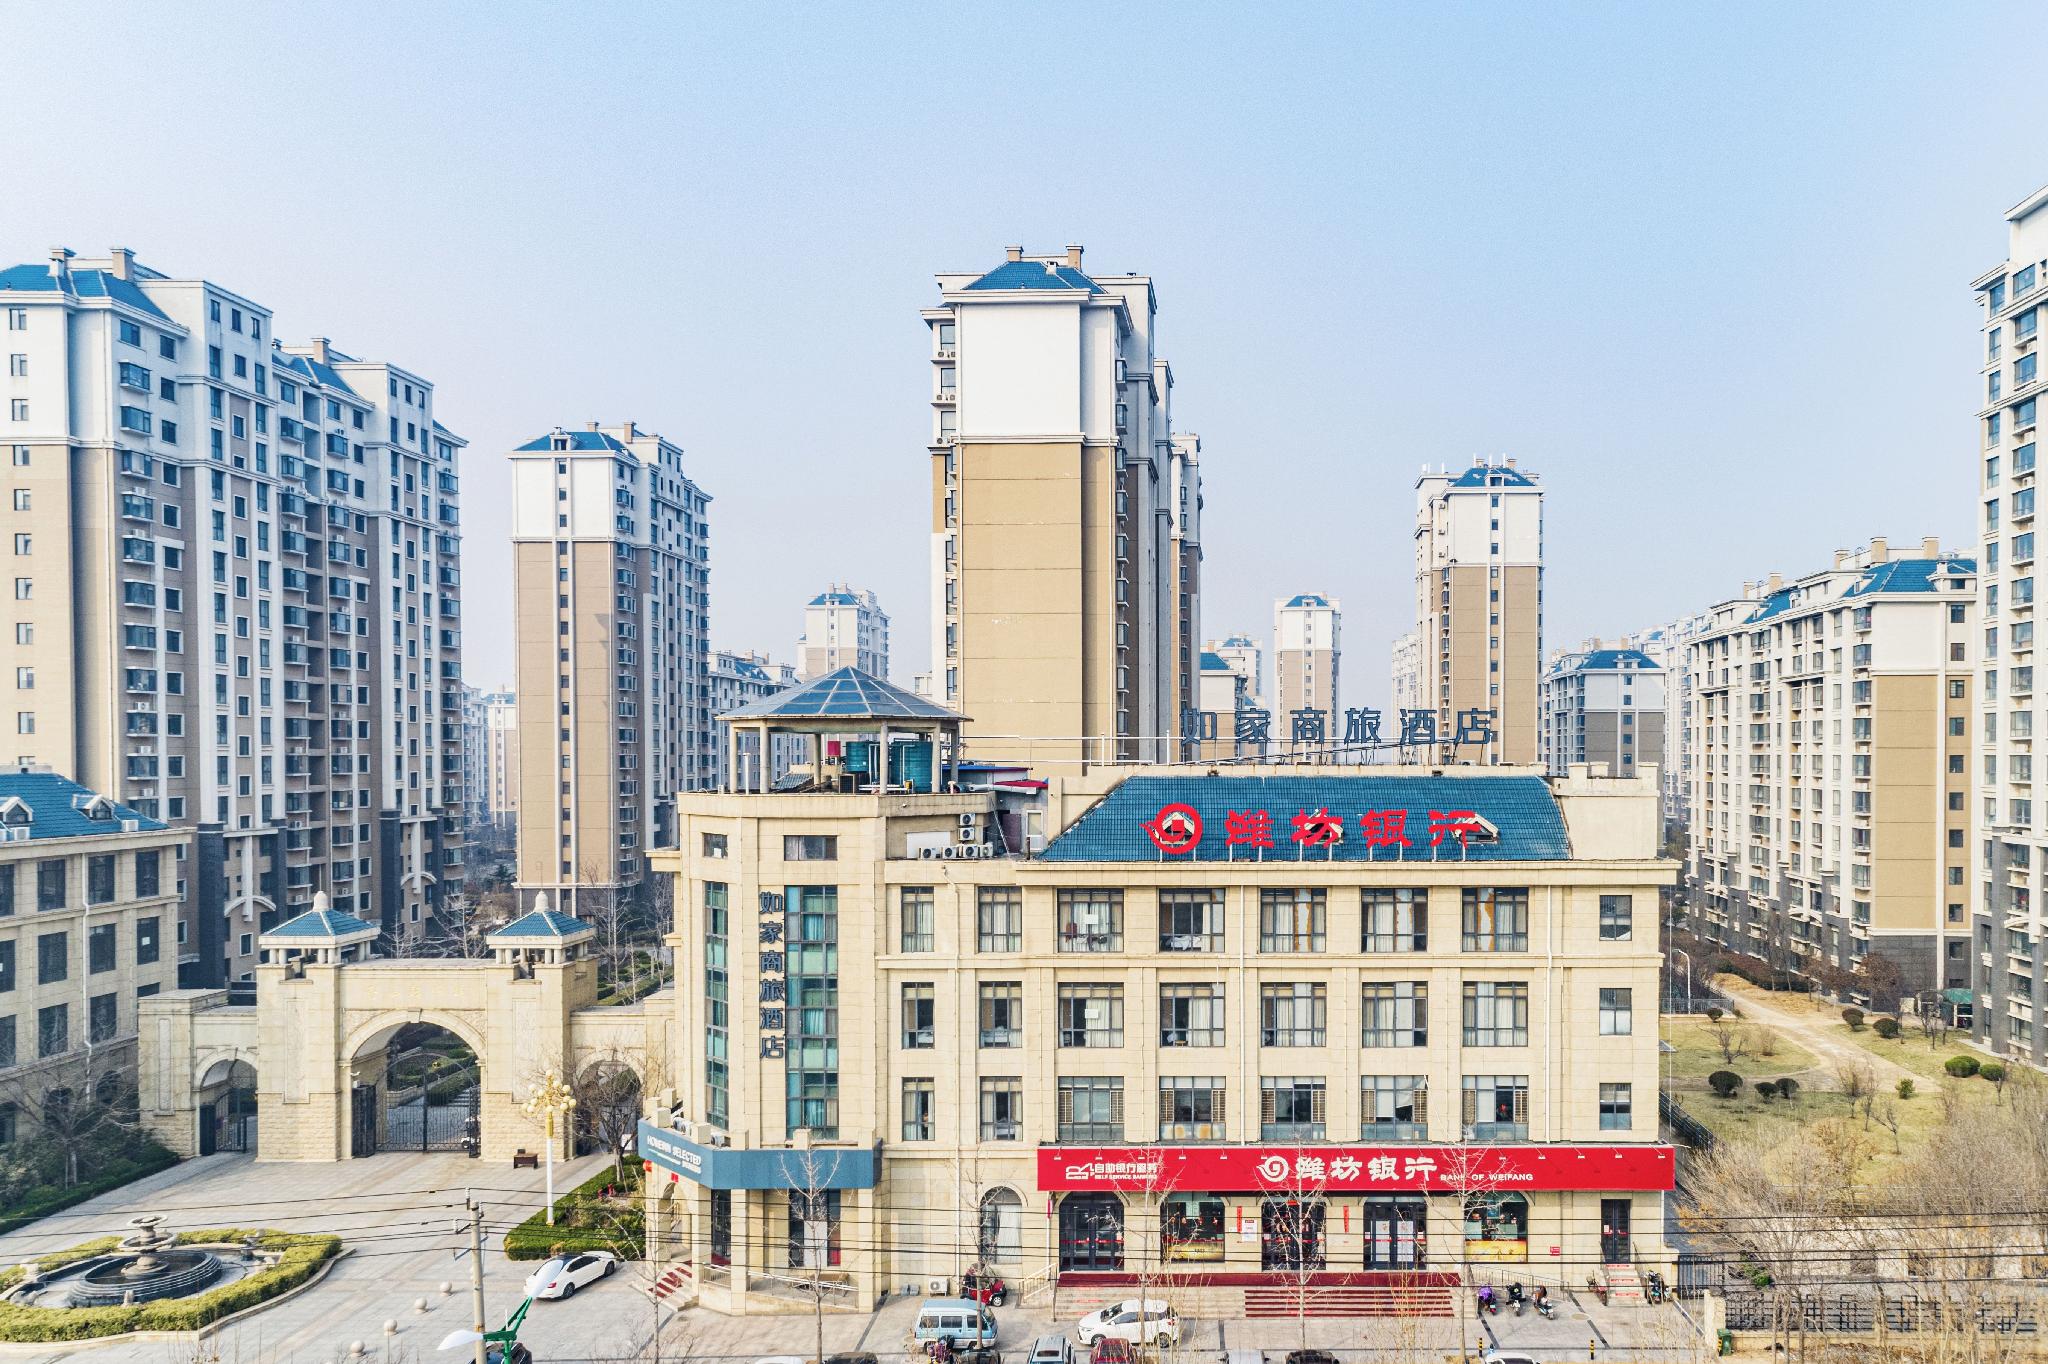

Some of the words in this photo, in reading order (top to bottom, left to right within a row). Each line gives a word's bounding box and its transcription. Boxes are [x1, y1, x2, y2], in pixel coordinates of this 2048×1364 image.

[1180, 707, 1491, 745] 如家商旅酒店
[1225, 808, 1481, 848] 潍坊银行
[759, 891, 784, 1059] 如家商旅酒店
[1296, 1156, 1437, 1181] 潍坊银行
